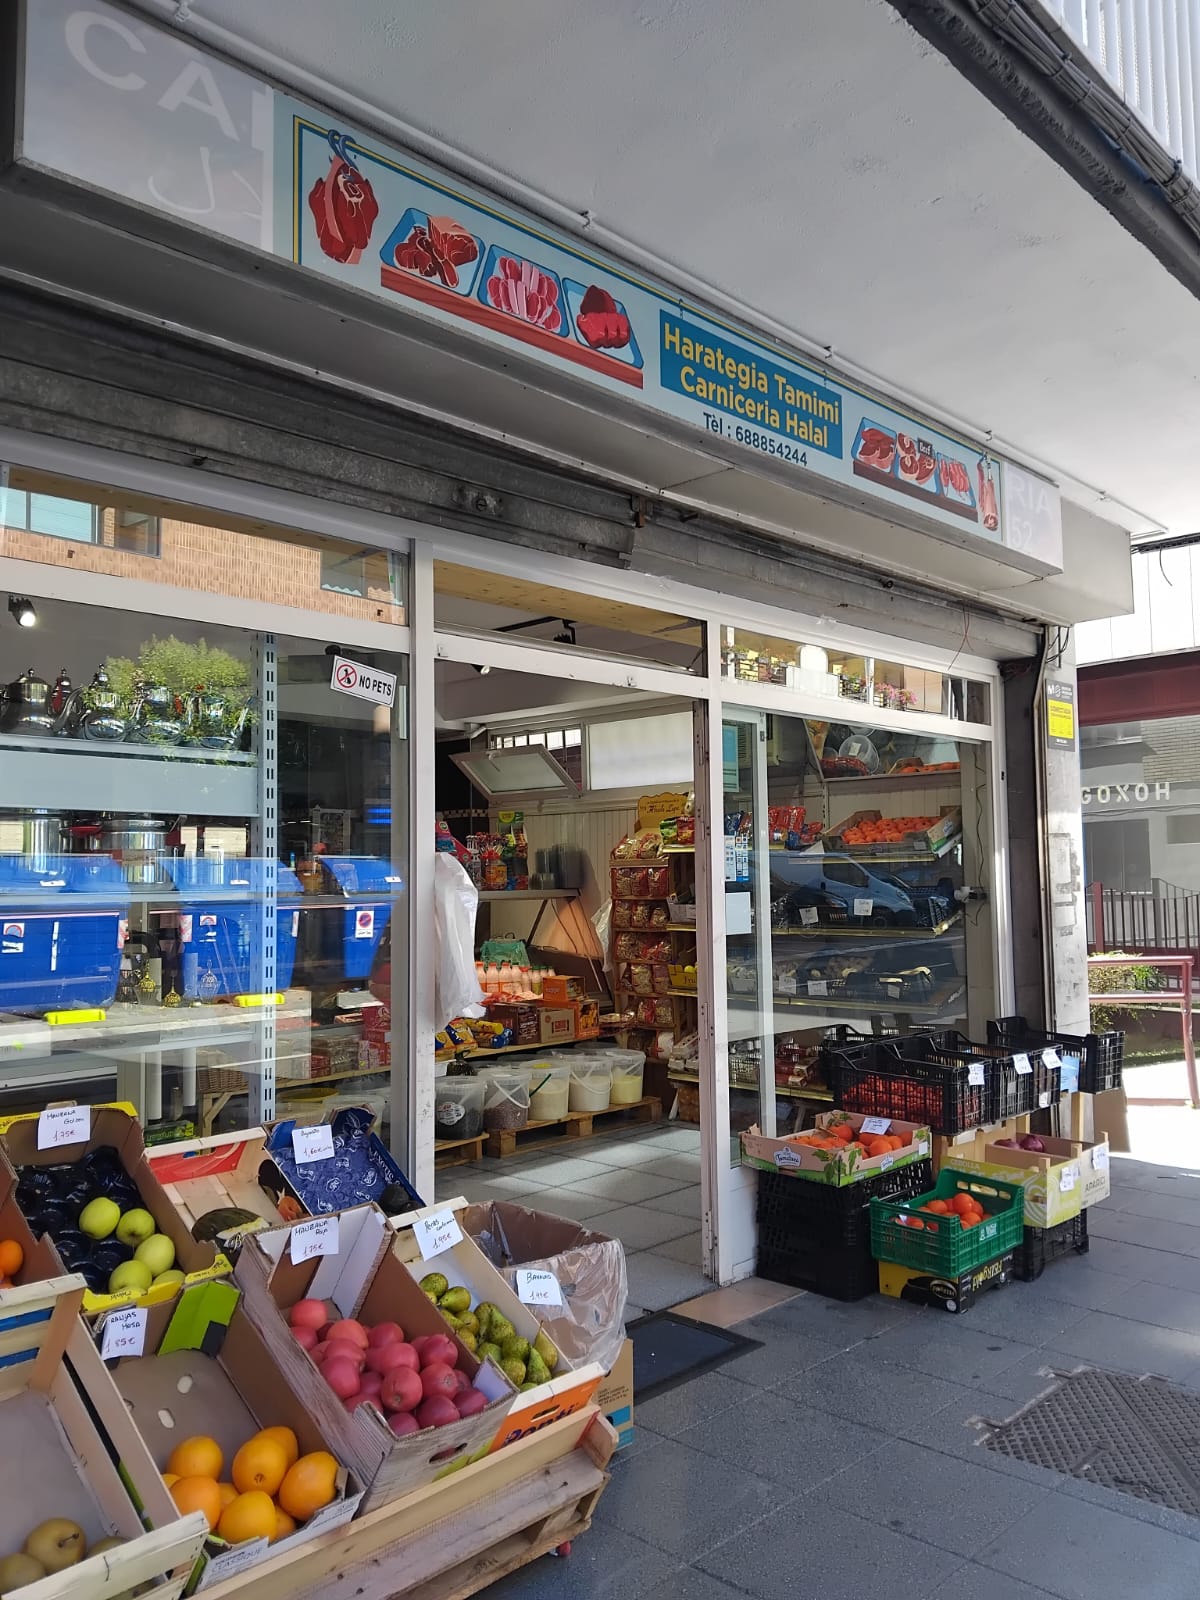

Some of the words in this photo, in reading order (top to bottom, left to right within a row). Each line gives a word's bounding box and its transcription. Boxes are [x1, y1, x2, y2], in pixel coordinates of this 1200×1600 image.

[664, 323, 768, 393] Harategia
[774, 374, 839, 425] Tamimi
[680, 366, 780, 429] Carniceria
[786, 410, 828, 448] Halal
[703, 411, 723, 435] Tèl
[735, 426, 808, 466] 688854244
[359, 675, 371, 689] NO
[372, 680, 392, 696] PETS
